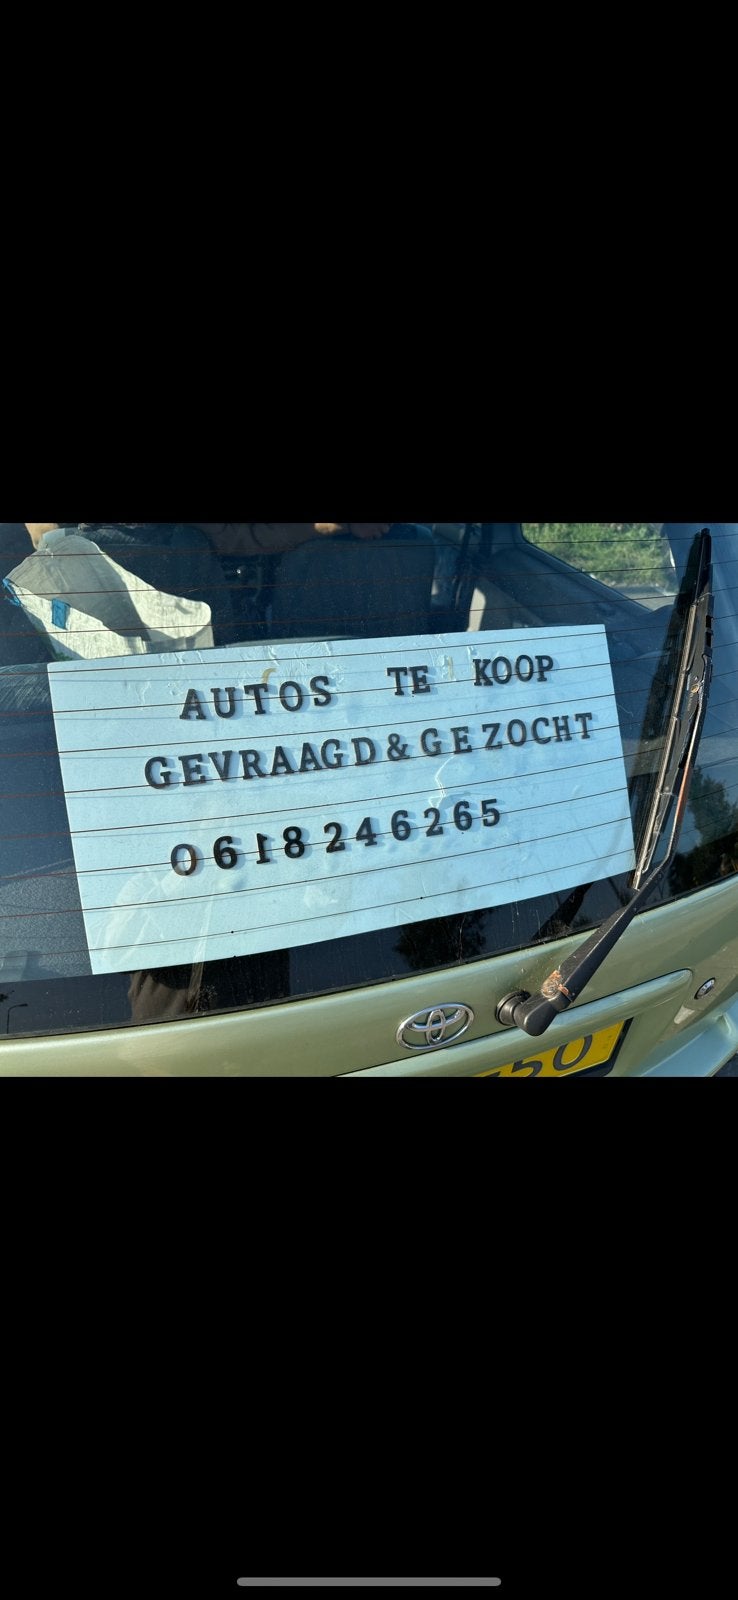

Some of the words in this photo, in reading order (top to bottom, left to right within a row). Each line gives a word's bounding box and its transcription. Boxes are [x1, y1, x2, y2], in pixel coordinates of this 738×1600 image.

[179, 675, 332, 720] AUTOS
[386, 665, 431, 695] TE
[472, 654, 554, 686] KOOP
